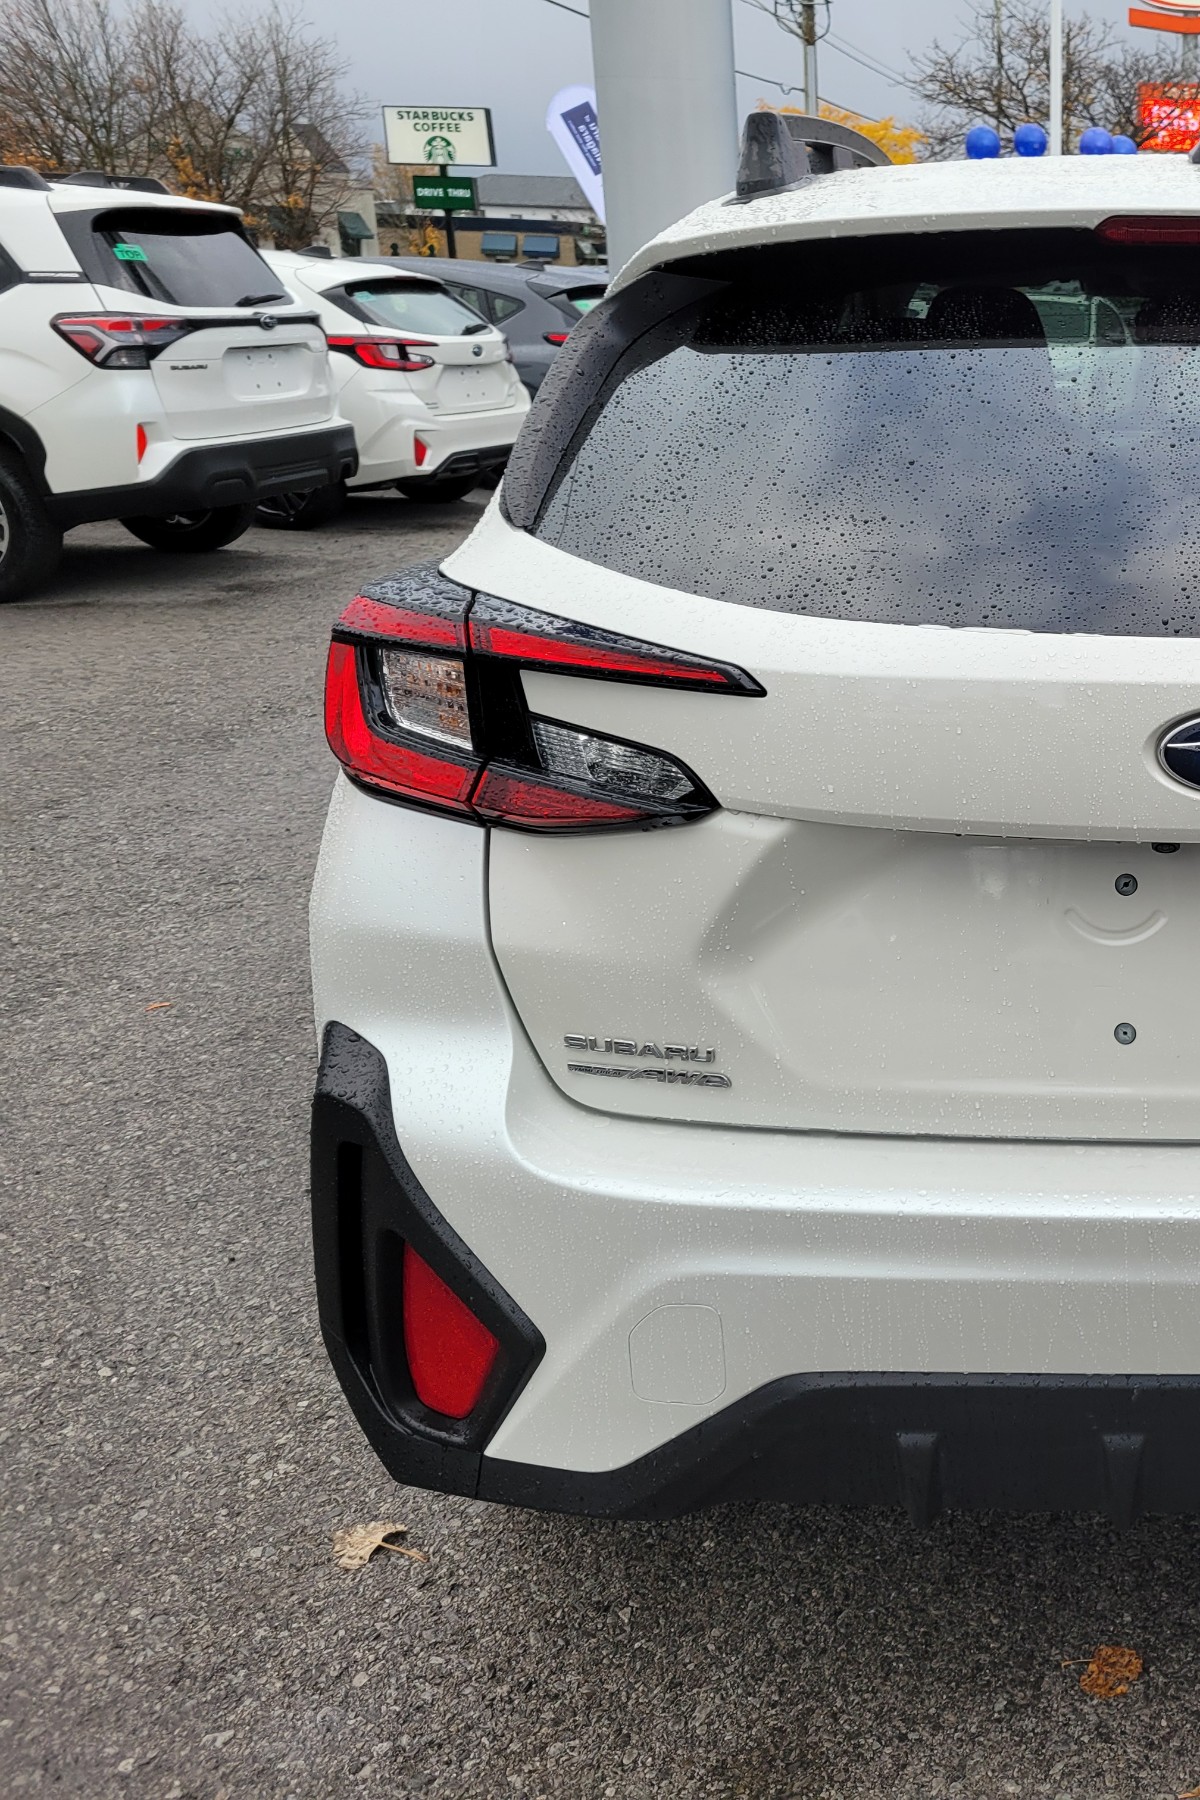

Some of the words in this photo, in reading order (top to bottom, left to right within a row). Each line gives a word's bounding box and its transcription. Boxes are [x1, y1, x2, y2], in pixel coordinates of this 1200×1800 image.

[397, 110, 474, 121] STARBUCKS
[413, 122, 462, 133] COFFEE
[416, 187, 444, 197] DRIVE
[446, 188, 471, 198] THRU
[563, 1033, 716, 1063] SUBARU
[628, 1067, 732, 1088] AWD
